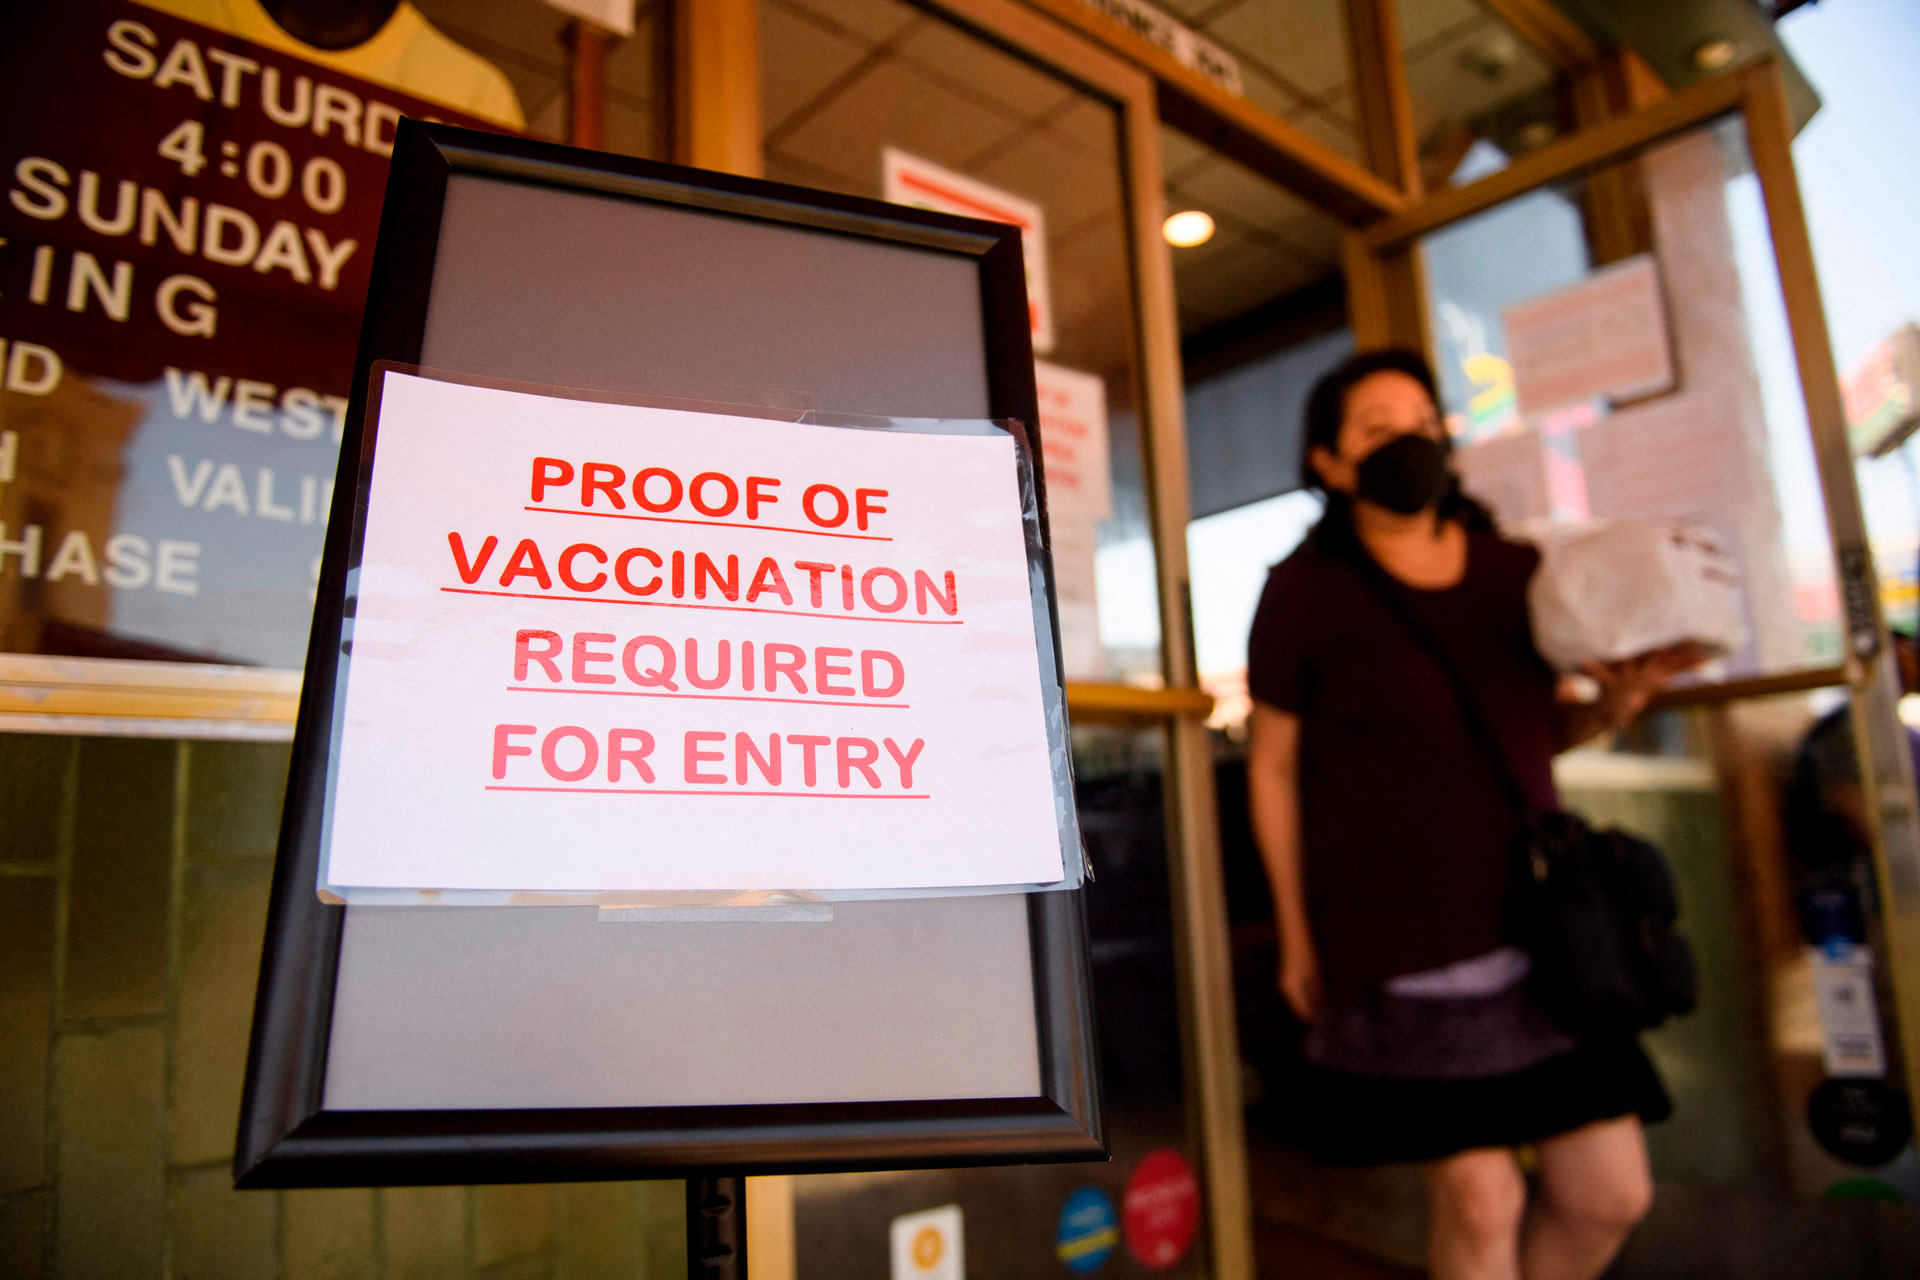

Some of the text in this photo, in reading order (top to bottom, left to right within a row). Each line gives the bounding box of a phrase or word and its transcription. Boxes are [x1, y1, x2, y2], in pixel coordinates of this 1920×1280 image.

[103, 20, 403, 158] SATURD
[158, 120, 347, 214] 4:00
[9, 157, 359, 291] SUNDAY
[0, 238, 218, 339] ING
[530, 456, 890, 532] PROOF OF
[447, 531, 959, 617] VACCINATION
[513, 628, 905, 699] REQUIRED
[491, 723, 926, 790] FOR ENTRY
